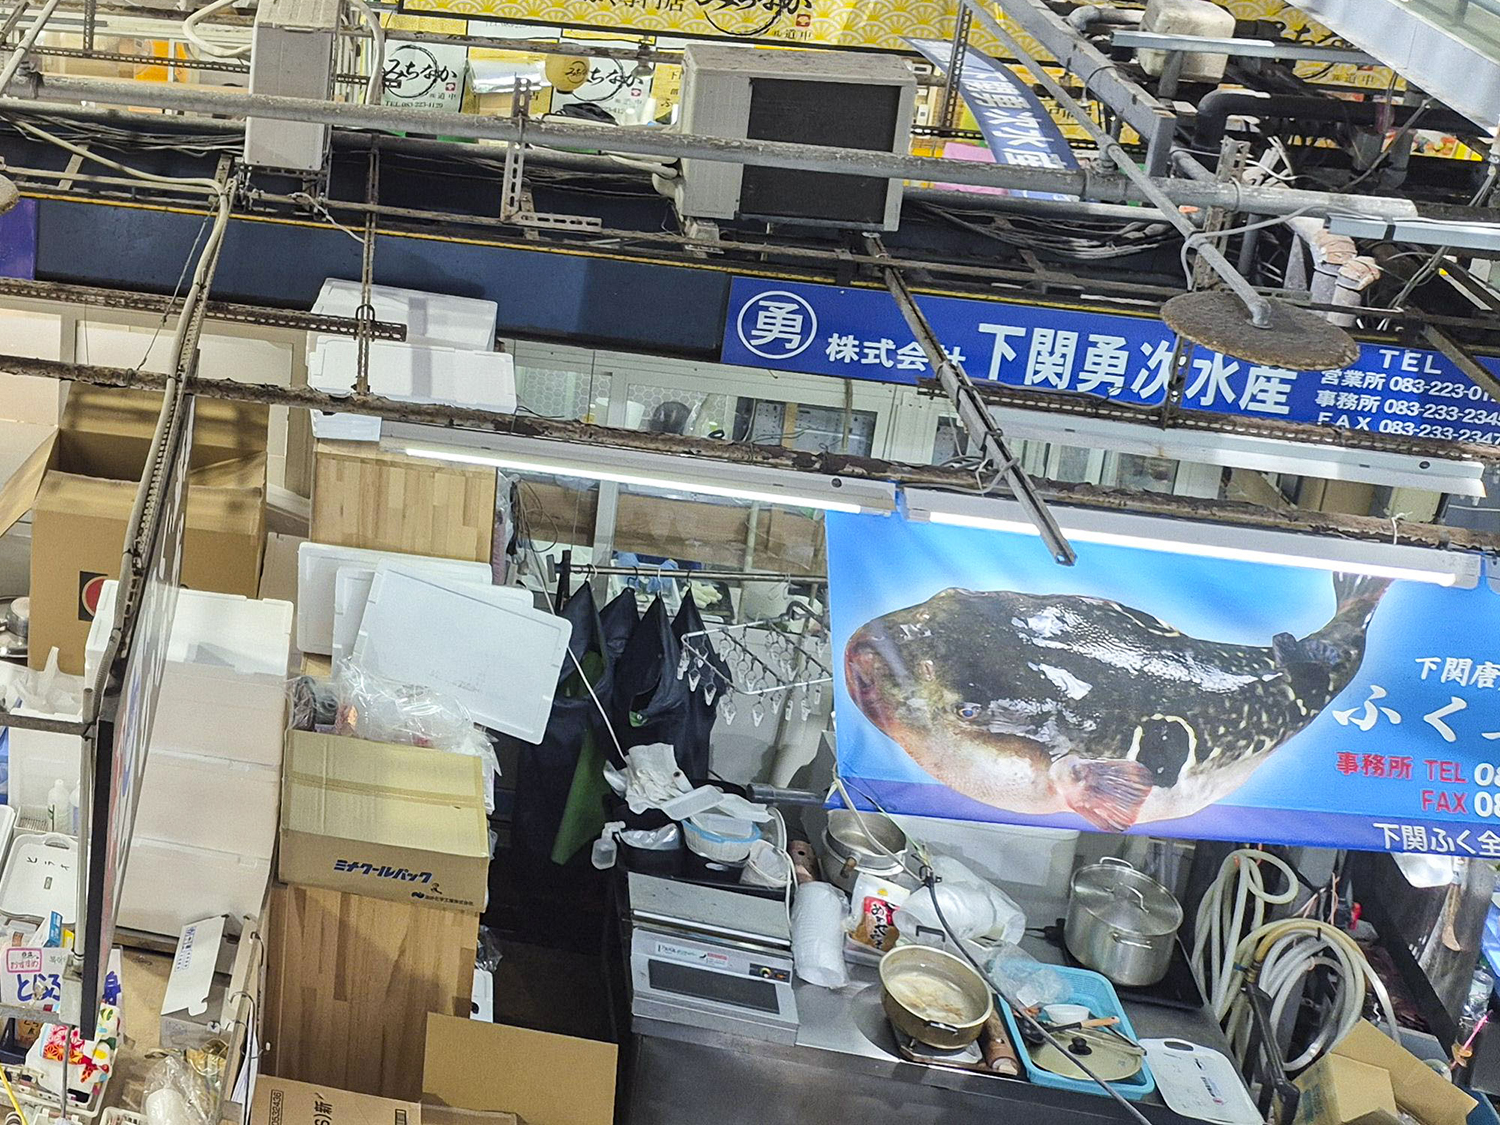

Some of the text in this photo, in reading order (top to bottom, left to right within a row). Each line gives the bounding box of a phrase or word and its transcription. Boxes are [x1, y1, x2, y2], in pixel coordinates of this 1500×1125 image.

[587, 66, 644, 88] ちなか
[977, 321, 1298, 415] 下関勇次水産
[1379, 349, 1442, 375] TEL
[1320, 369, 1387, 391] 営業所
[1315, 390, 1381, 414] 事務所
[1317, 412, 1372, 432] FAX
[1331, 684, 1500, 743] ふく
[1336, 751, 1414, 780] 事務所
[1424, 759, 1468, 784] TEL
[1421, 789, 1468, 814] FAX
[333, 859, 433, 884] ミナクールパック
